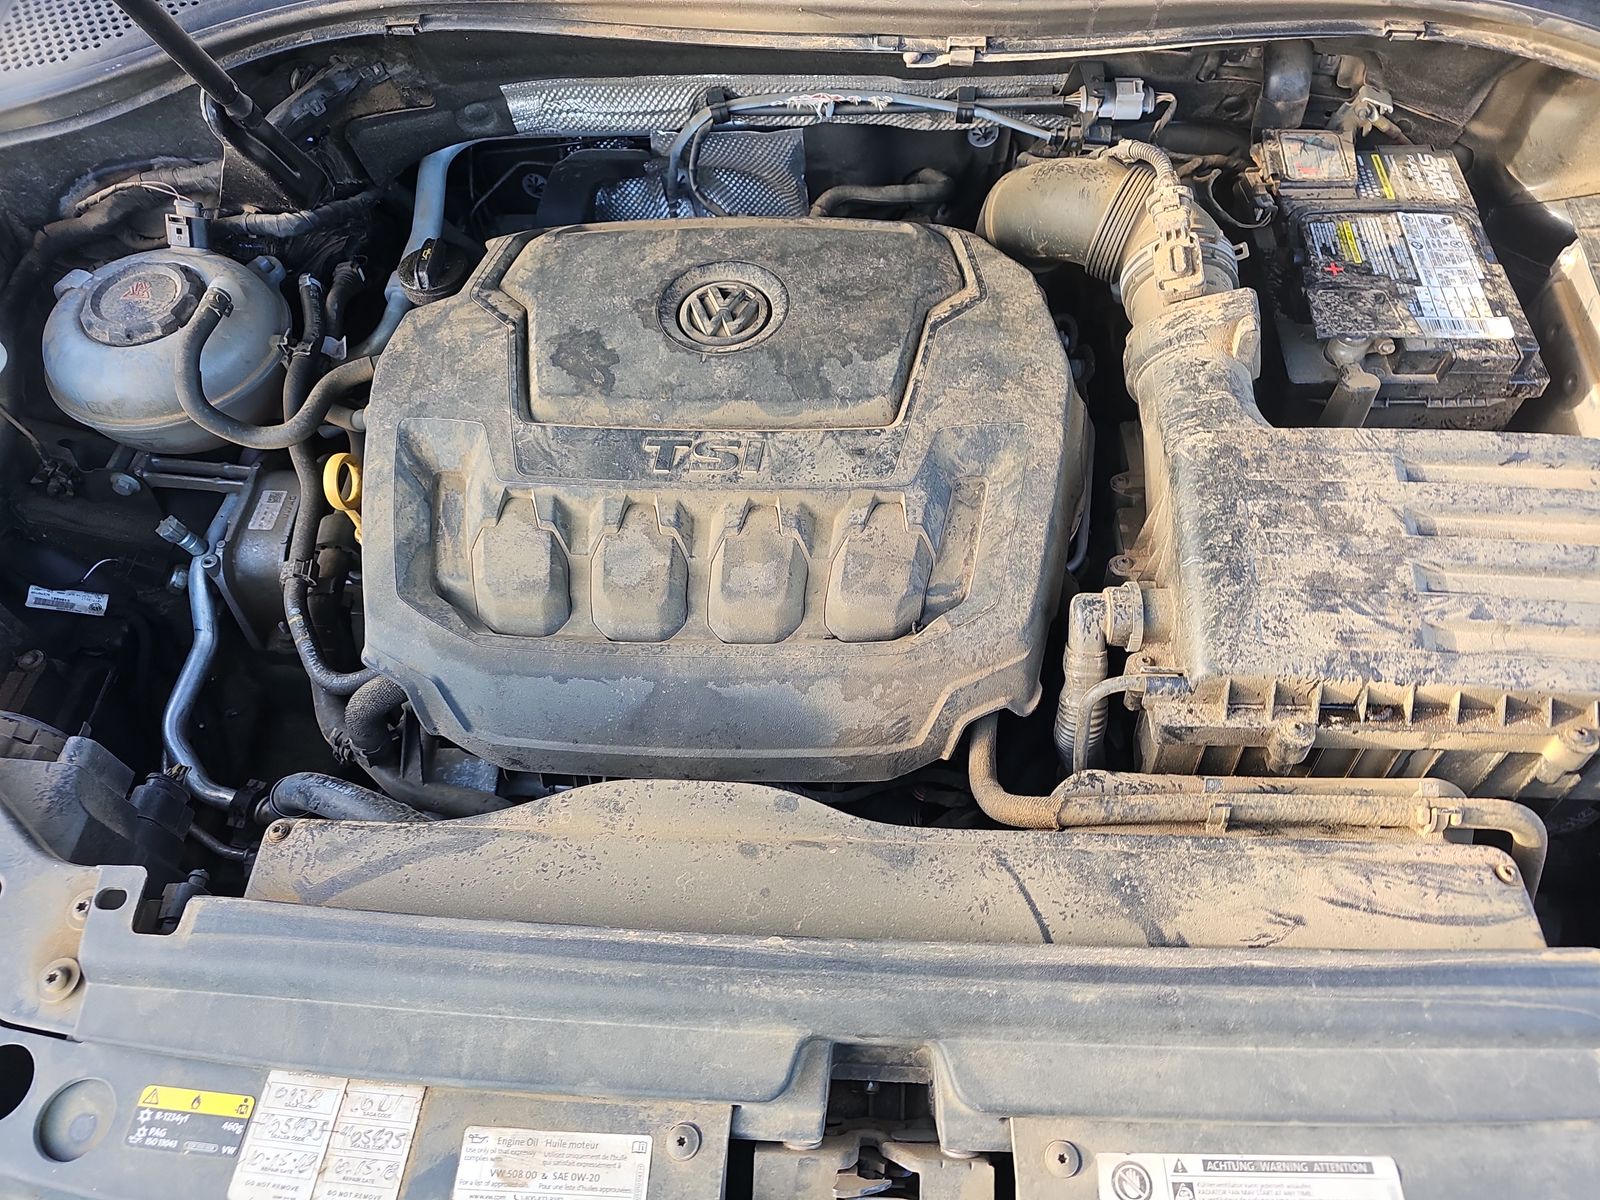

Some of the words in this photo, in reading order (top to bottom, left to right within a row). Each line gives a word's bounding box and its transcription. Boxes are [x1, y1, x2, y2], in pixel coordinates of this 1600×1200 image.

[1417, 152, 1448, 198] START
[1437, 157, 1461, 199] SUPER
[644, 437, 766, 473] TSI
[154, 1111, 191, 1125] R-1234yf
[148, 1126, 167, 1137] PAG
[221, 1121, 244, 1135] 460g
[497, 1137, 525, 1148] Engine
[526, 1137, 539, 1147] Oil
[545, 1139, 567, 1148] Huile
[221, 1146, 238, 1155] VW
[1206, 1160, 1254, 1172] ACHTUNG
[1260, 1161, 1308, 1172] WARNING
[1313, 1162, 1368, 1173] ATTENTION
[490, 1168, 505, 1178] VW
[506, 1169, 523, 1179] 508
[525, 1170, 538, 1179] 00
[552, 1171, 569, 1181] SAE
[570, 1172, 601, 1182] 0W-20
[244, 1179, 254, 1187] DO
[271, 1183, 300, 1192] REMOVE
